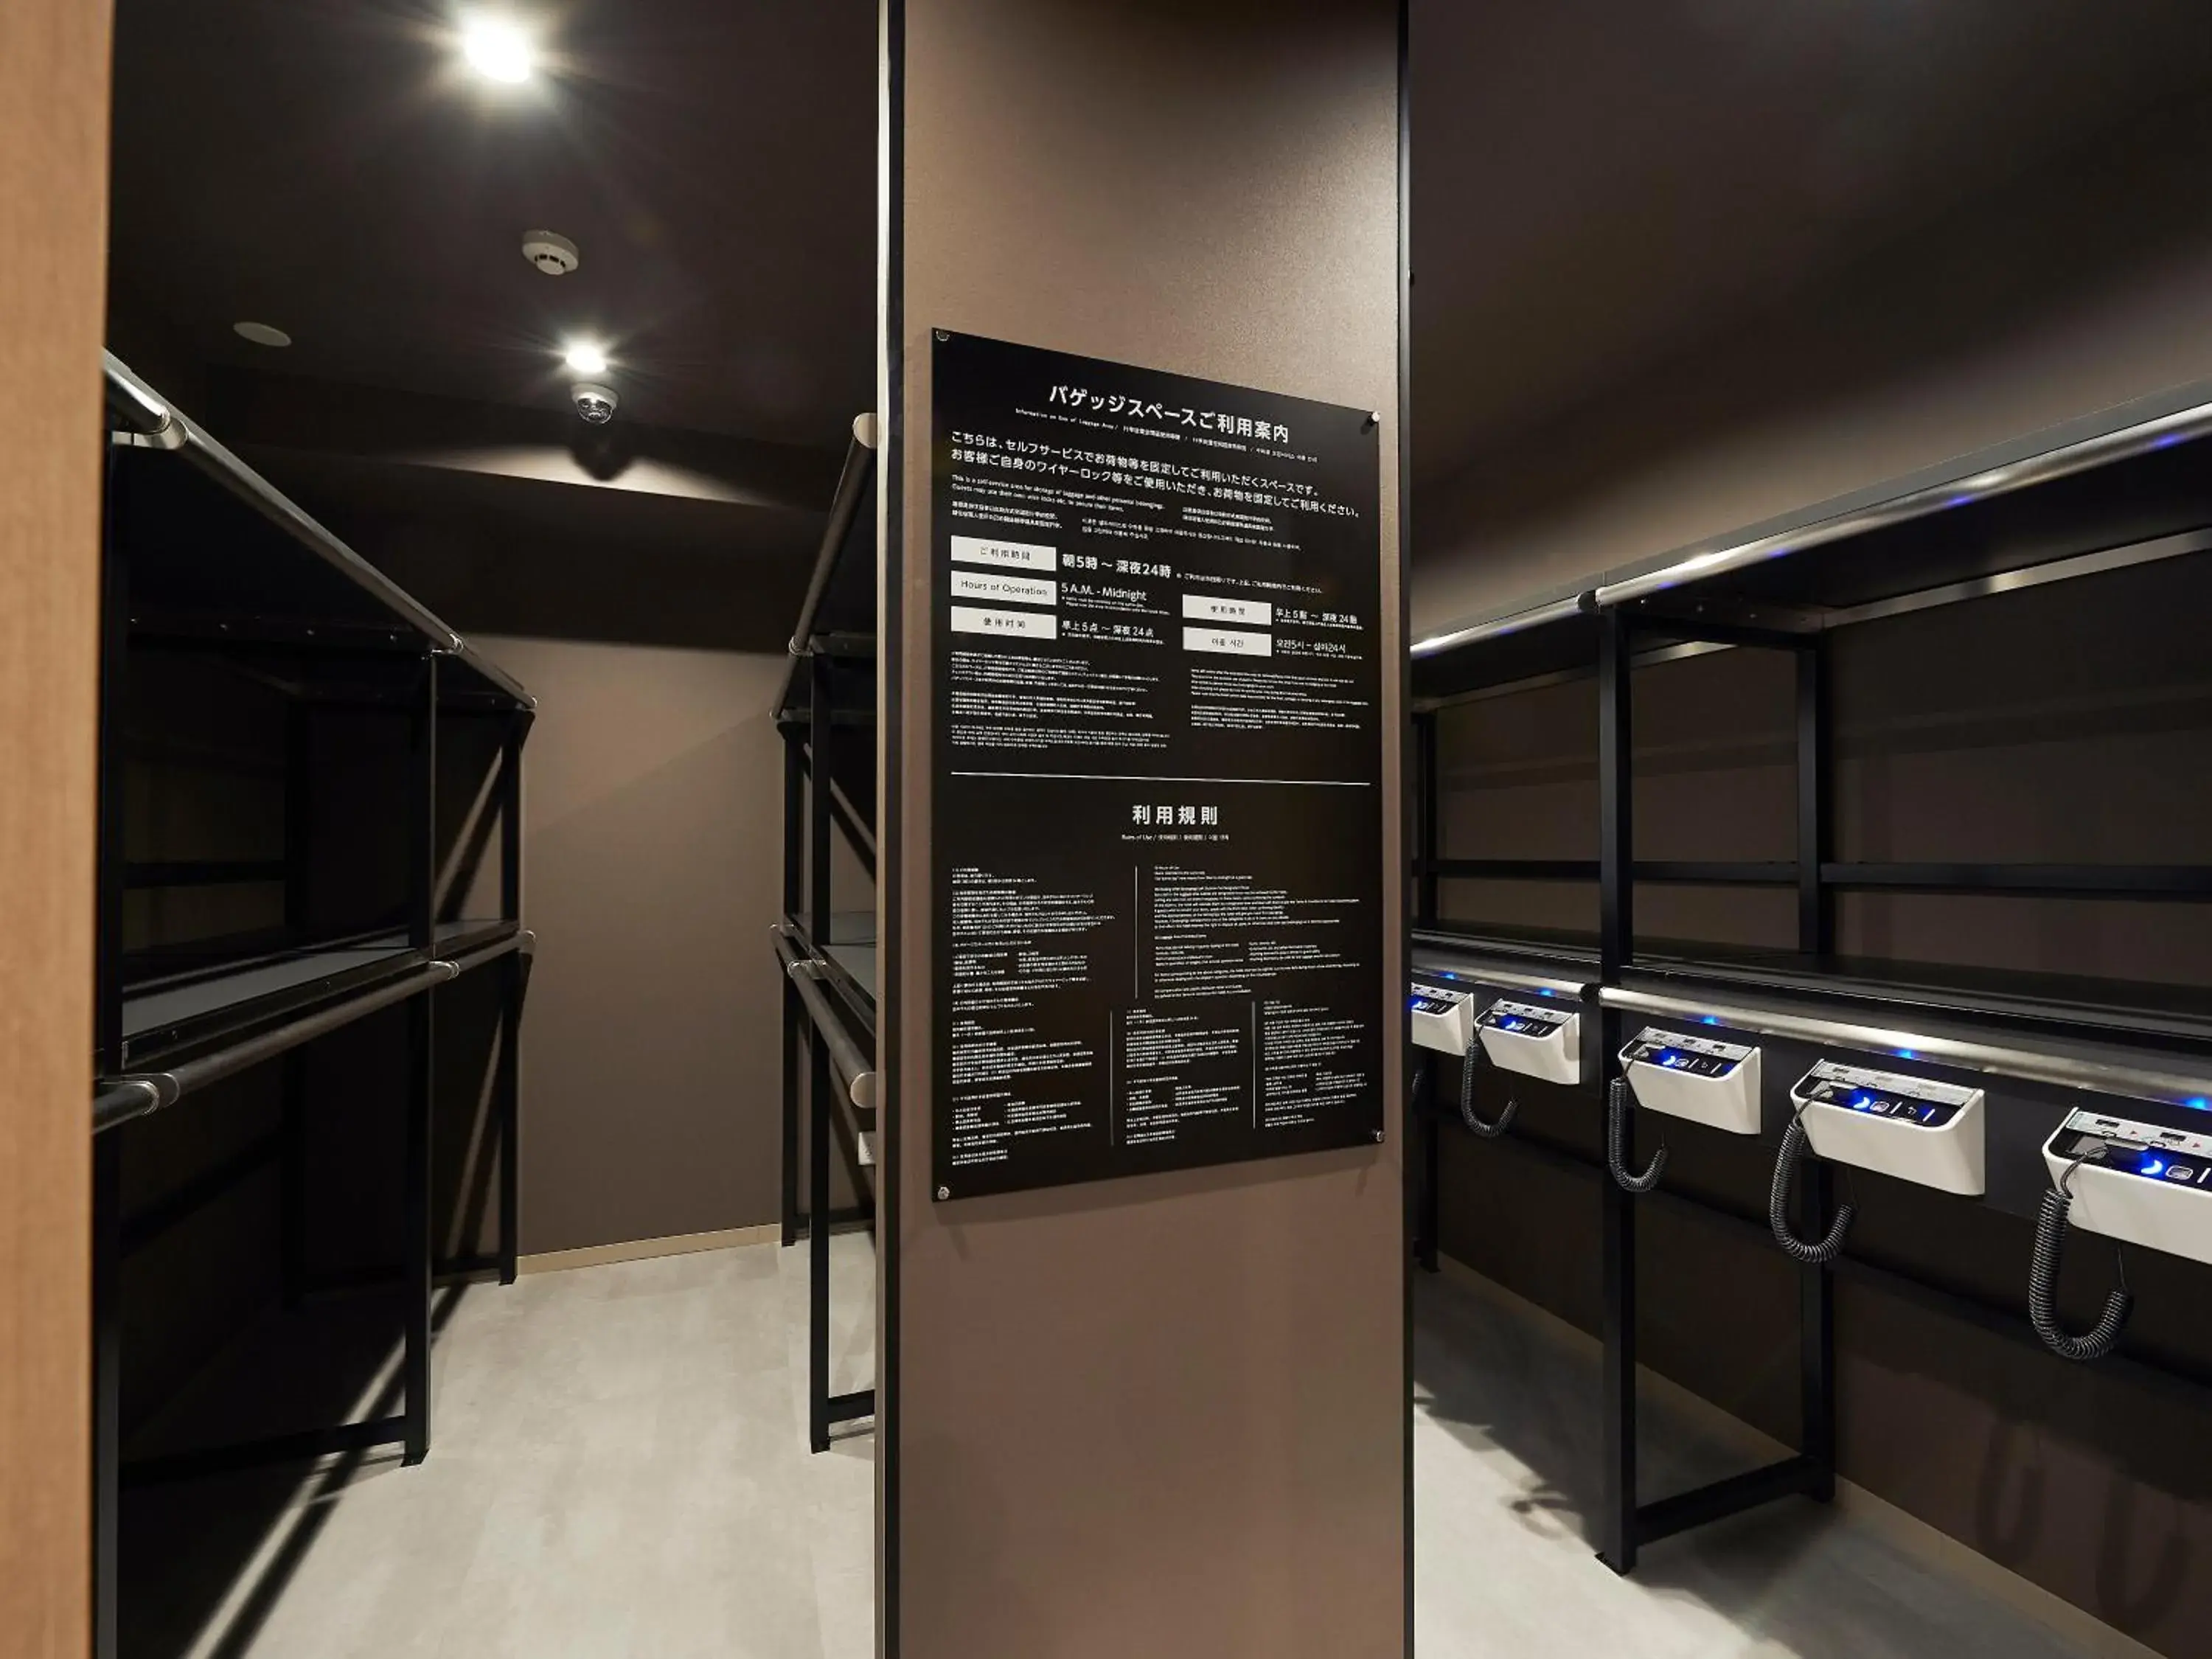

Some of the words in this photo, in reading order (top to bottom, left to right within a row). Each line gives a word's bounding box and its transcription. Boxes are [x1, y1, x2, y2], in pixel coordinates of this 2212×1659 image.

[1049, 385, 1290, 444] バゲッジスペースご利用案内
[950, 430, 1319, 497] こちらは、セルフサービスでお荷物等を固定してご利用いただくスペースです。
[950, 448, 1360, 518] お客様ご自身のワイヤーロック等をご使用いただき、お荷物を固定してご利用ください。
[980, 546, 1031, 561] ご利用時間
[1116, 559, 1171, 580] 深夜24時
[961, 580, 987, 591] Hours
[990, 582, 1001, 591] of
[1002, 584, 1048, 596] Operation
[1061, 582, 1069, 593] 5
[1102, 588, 1147, 602] Midnight
[1132, 804, 1218, 826] 利用規則
